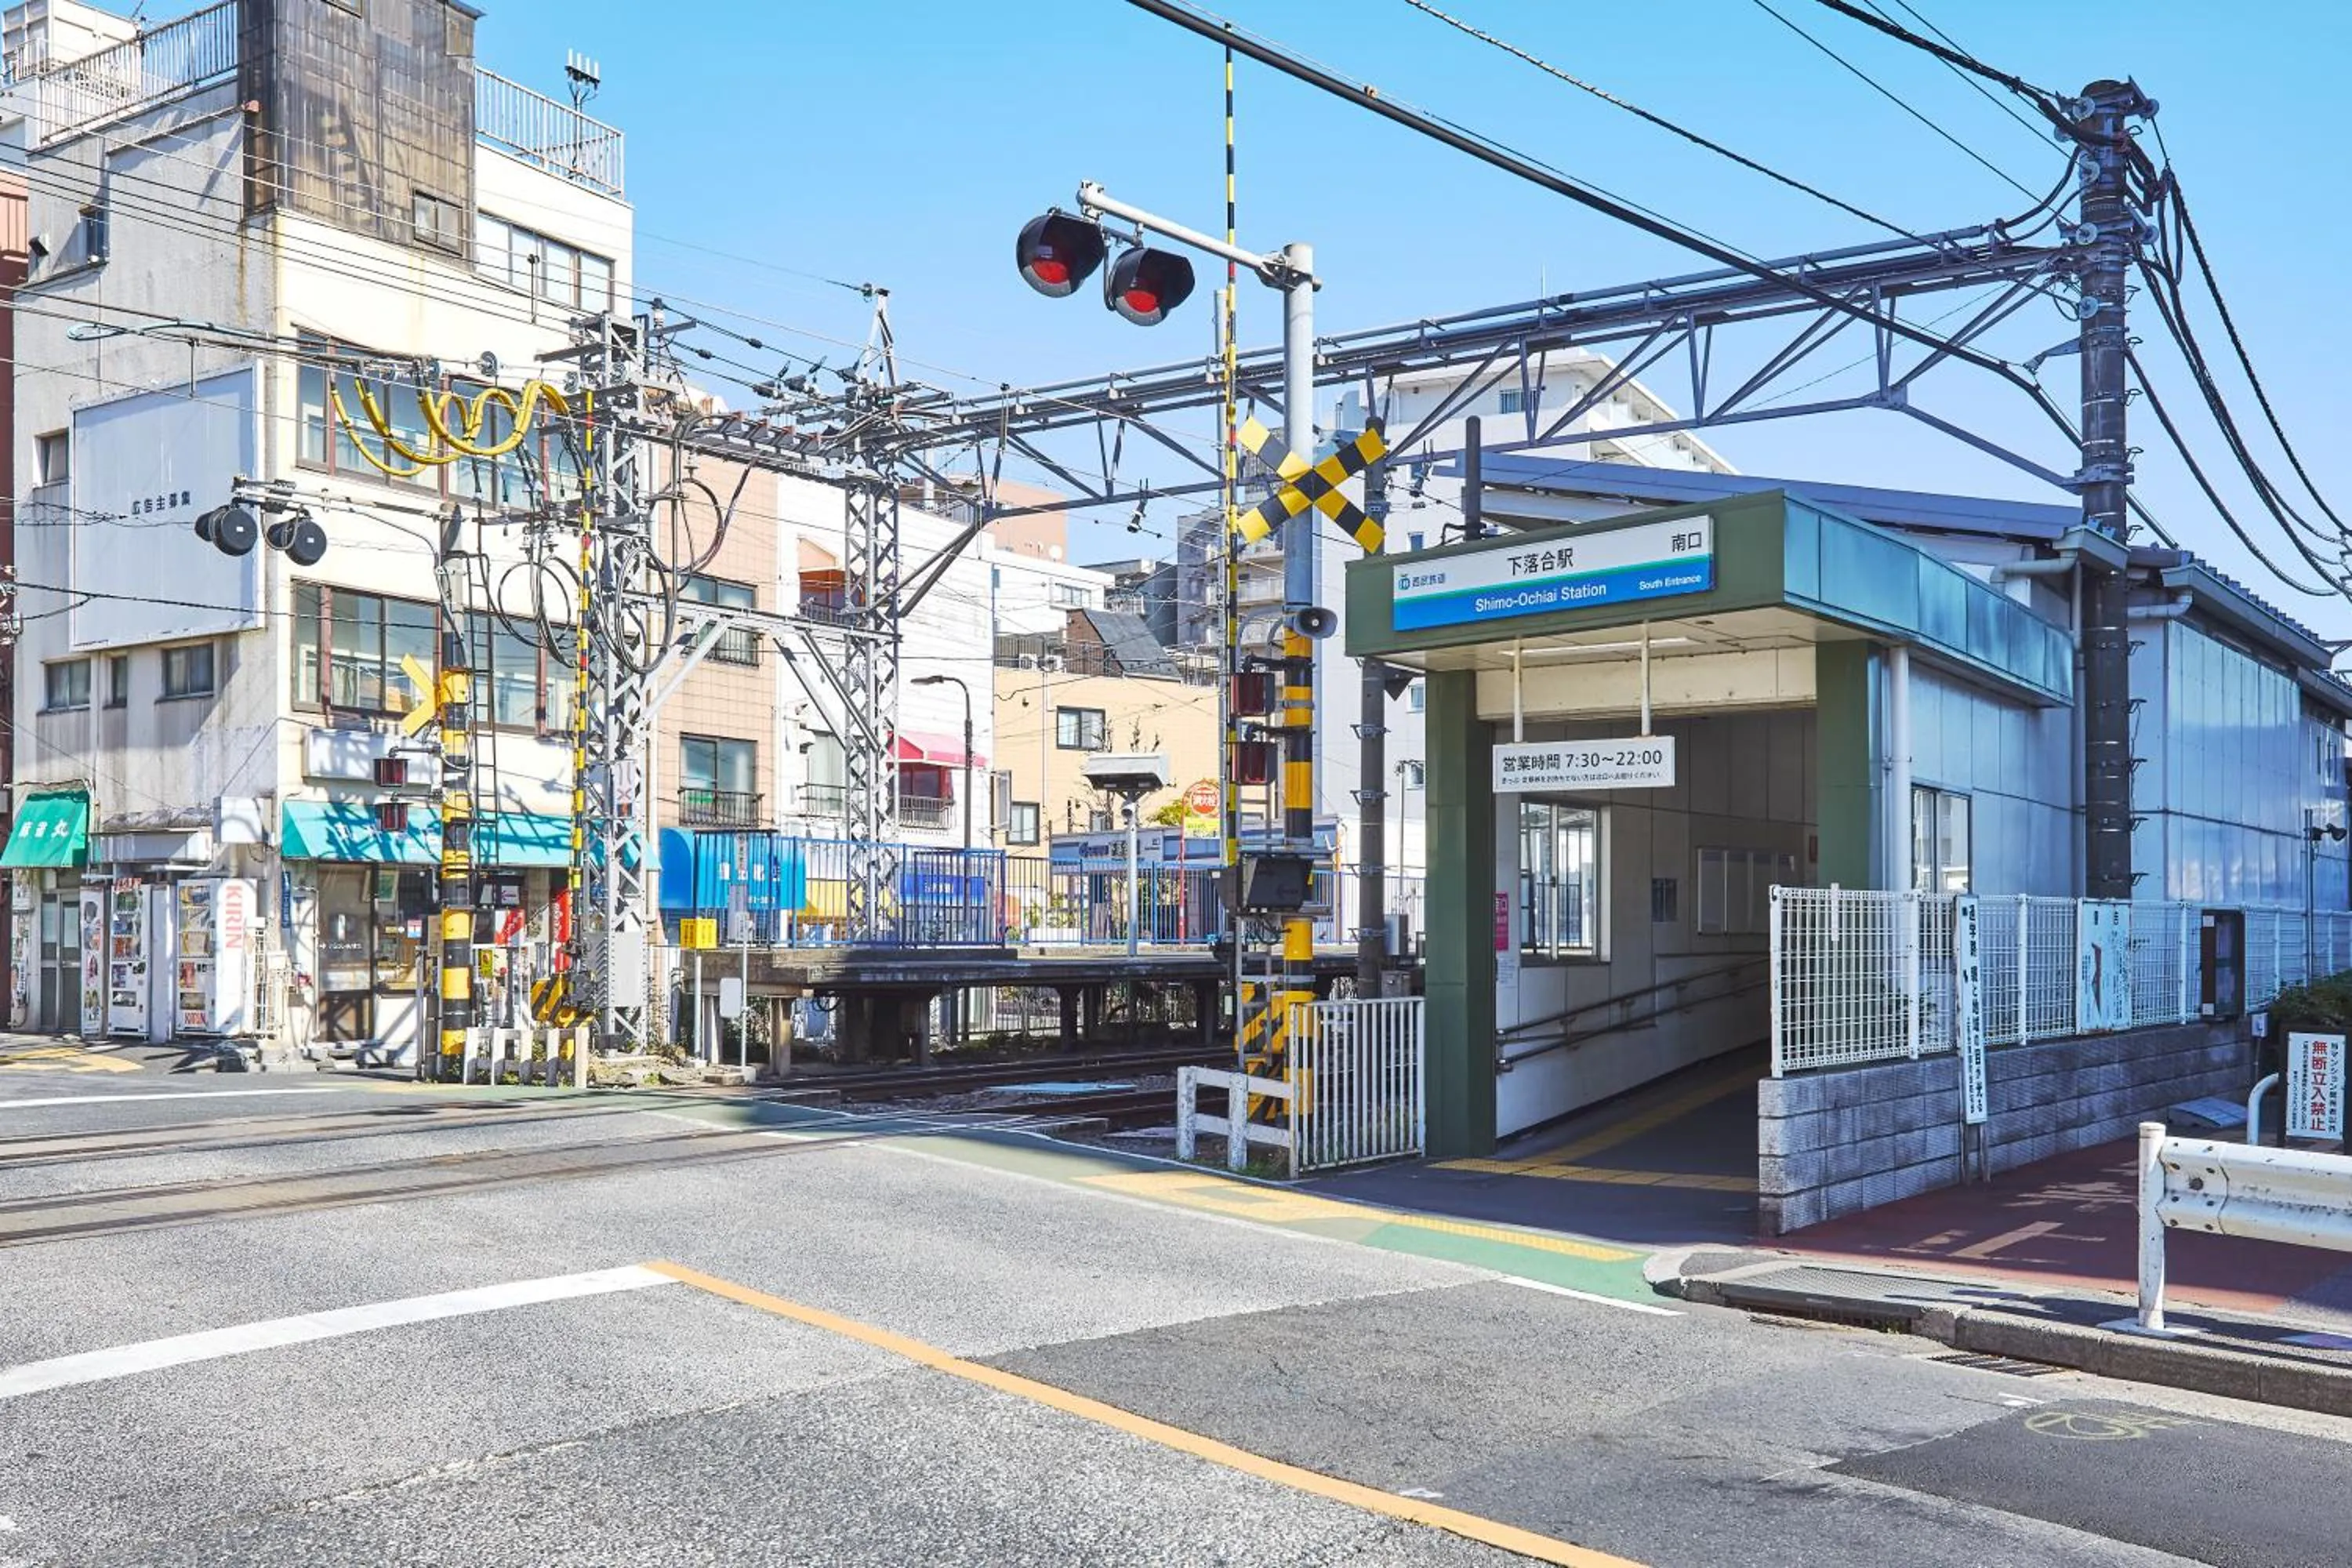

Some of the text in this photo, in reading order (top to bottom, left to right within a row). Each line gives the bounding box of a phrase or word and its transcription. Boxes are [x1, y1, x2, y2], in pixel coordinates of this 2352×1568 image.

[1671, 532, 1702, 553] 南口
[1507, 548, 1574, 576] 下落合駅
[1412, 573, 1446, 587] 西武鉄道
[1639, 575, 1702, 590] South Entrance
[1475, 583, 1606, 613] Shimo-Ochiai Station
[1503, 753, 1560, 772] 営業時間
[225, 885, 243, 949] KIRIN
[2310, 1040, 2328, 1131] 無断立入禁止
